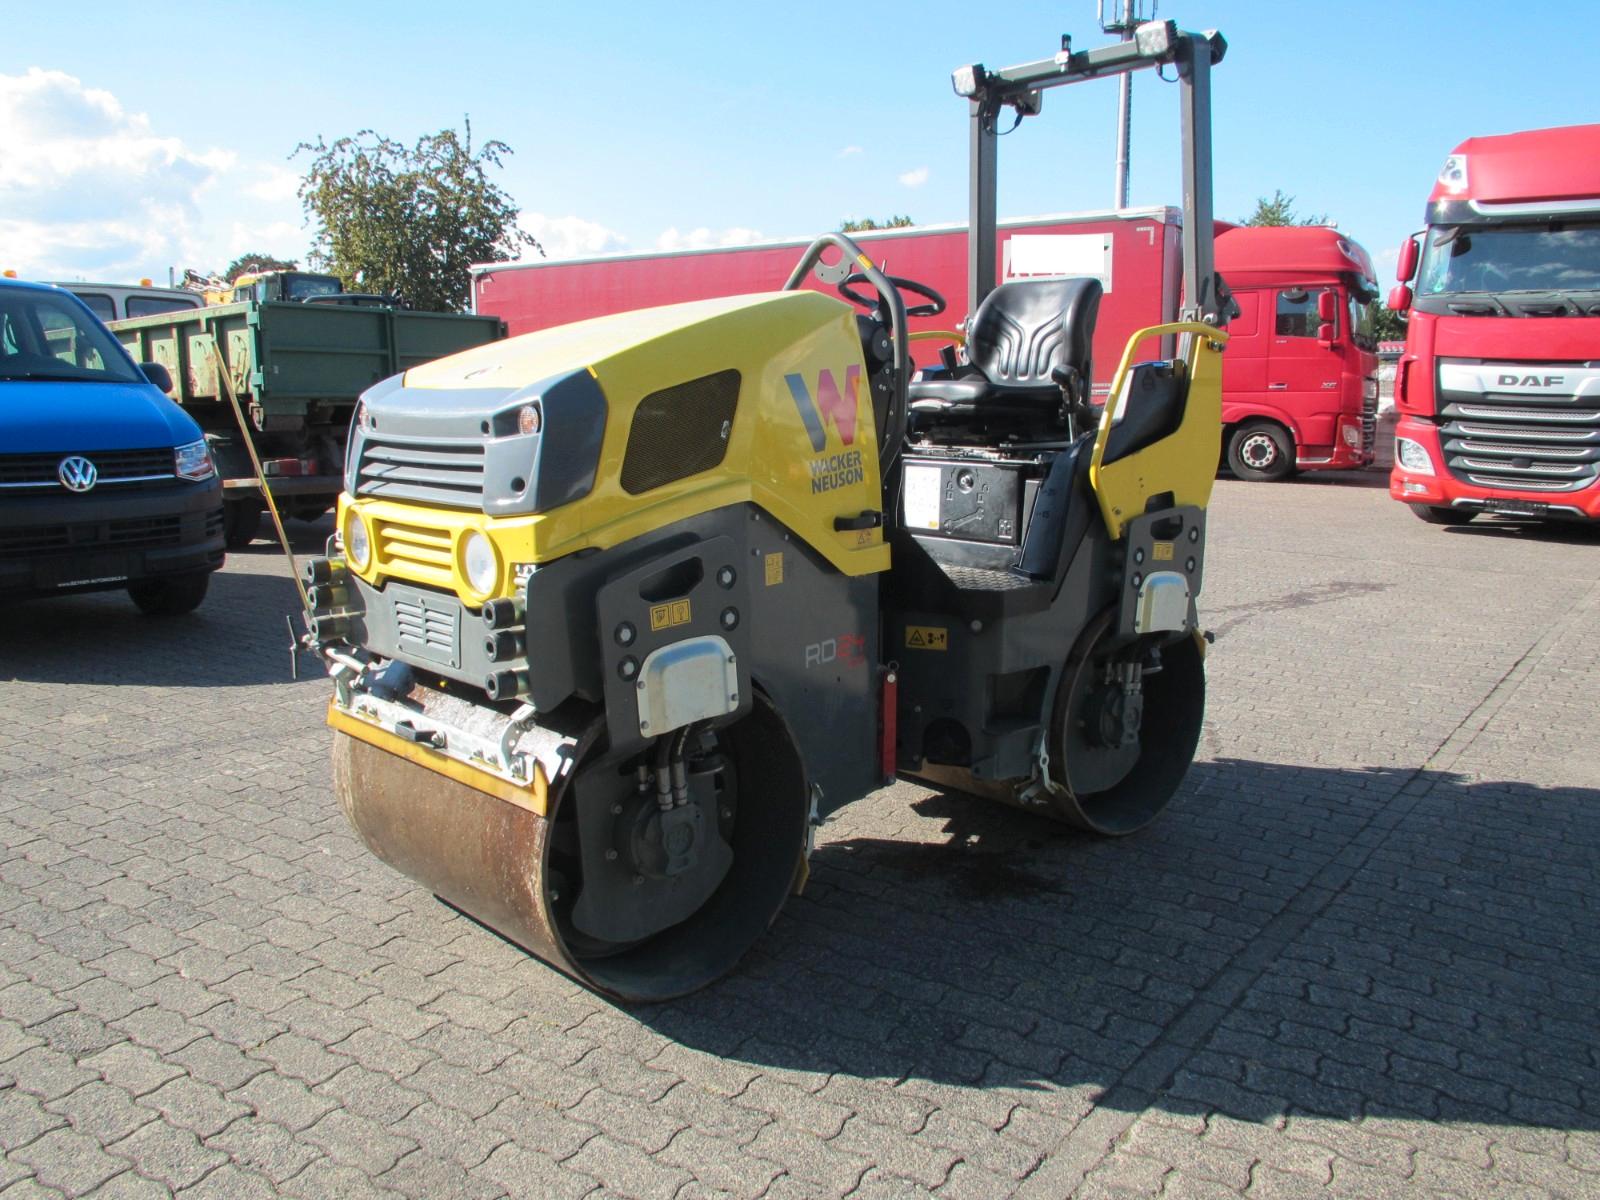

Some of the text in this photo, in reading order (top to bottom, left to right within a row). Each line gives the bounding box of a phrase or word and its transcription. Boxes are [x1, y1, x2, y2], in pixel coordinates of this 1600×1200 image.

[1497, 374, 1566, 388] DAF
[808, 450, 862, 477] WACKER
[811, 467, 864, 495] NEUSON
